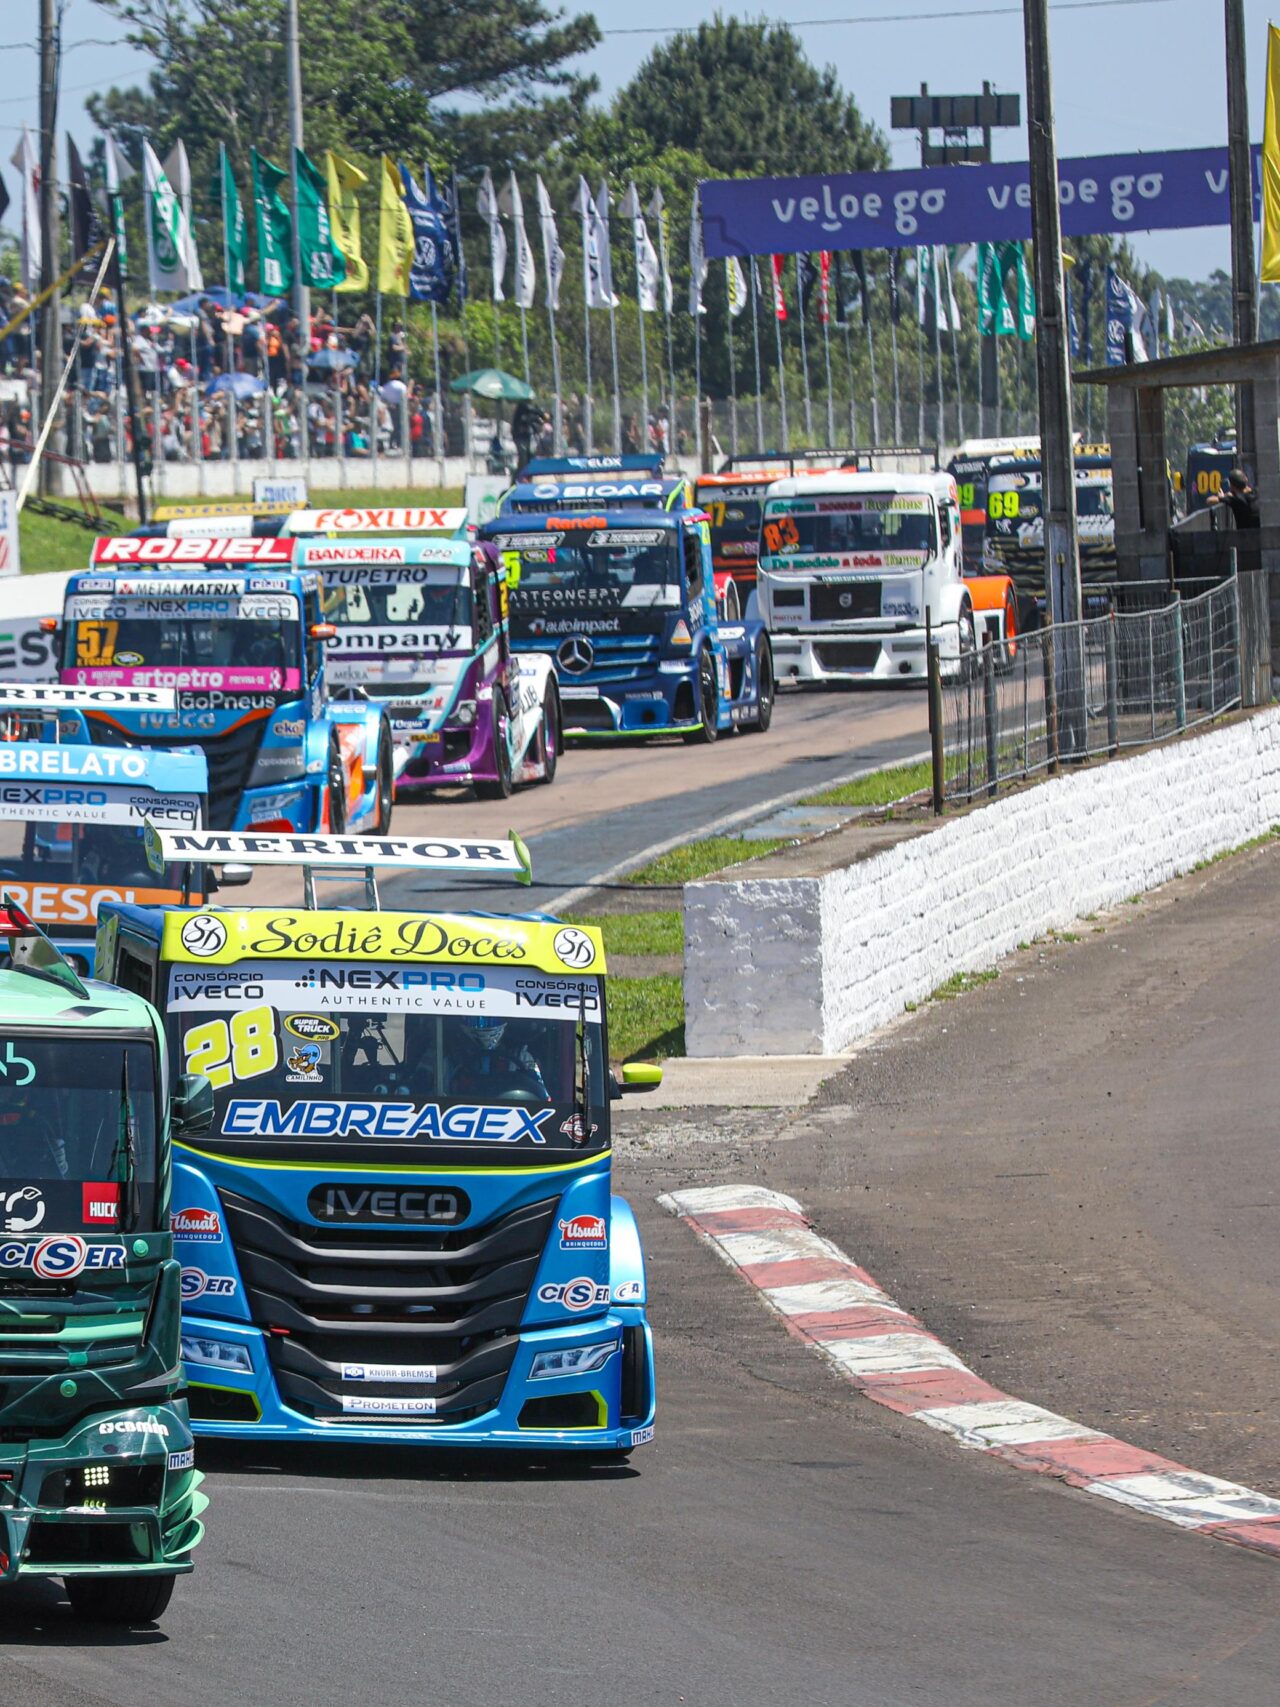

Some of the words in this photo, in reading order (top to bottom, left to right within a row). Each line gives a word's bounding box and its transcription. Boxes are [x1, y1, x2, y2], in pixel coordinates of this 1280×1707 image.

[987, 173, 1098, 209] veoe
[1110, 172, 1163, 221] go
[772, 184, 883, 232] veloe
[893, 188, 946, 235] go
[1196, 470, 1221, 495] 00
[988, 491, 1020, 519] 69
[315, 509, 448, 529] FOXLUX
[764, 516, 800, 551] 83
[100, 538, 289, 561] ROBIEL
[307, 547, 403, 562] BANDEIRA
[135, 583, 240, 596] METALMATRIX
[73, 606, 127, 618] IVECO
[146, 600, 230, 613] NEXPRO
[239, 606, 291, 618] IVECO
[545, 618, 620, 634] autoimpact
[76, 620, 119, 660] 57
[326, 633, 462, 650] ompany
[131, 667, 224, 689] artpetro
[180, 690, 276, 711] ãoPneus
[139, 712, 215, 729] IVECO
[129, 795, 195, 809] CONSÓRCIO
[66, 810, 108, 820] VALUE
[128, 805, 195, 822] IVECO
[170, 835, 516, 862] MERITOR
[250, 916, 383, 957] Sodiê
[393, 918, 527, 960] Doces
[174, 970, 264, 983] CONSÓRCIO
[319, 968, 487, 993] NEXPRO
[174, 984, 264, 1001] IVECO
[514, 977, 599, 994] CONSÓRCIO
[319, 994, 425, 1008] AUTHENTIC
[432, 998, 487, 1010] VALUE
[514, 991, 599, 1010] IVECO
[293, 1018, 320, 1026] SUPER
[297, 1024, 331, 1034] TRUCK
[183, 1004, 282, 1093] 28
[286, 1074, 323, 1082] CAMILINHO
[221, 1099, 558, 1145] EMBREAGEX
[88, 1199, 120, 1219] HUCK
[326, 1189, 459, 1220] IVECO
[170, 1213, 219, 1231] Usual
[560, 1217, 605, 1239] Usual
[180, 1271, 234, 1297] SER
[368, 1367, 435, 1379] KNORR-BREMSE
[349, 1397, 435, 1414] PROMETEON
[170, 1453, 194, 1469] MAHL
